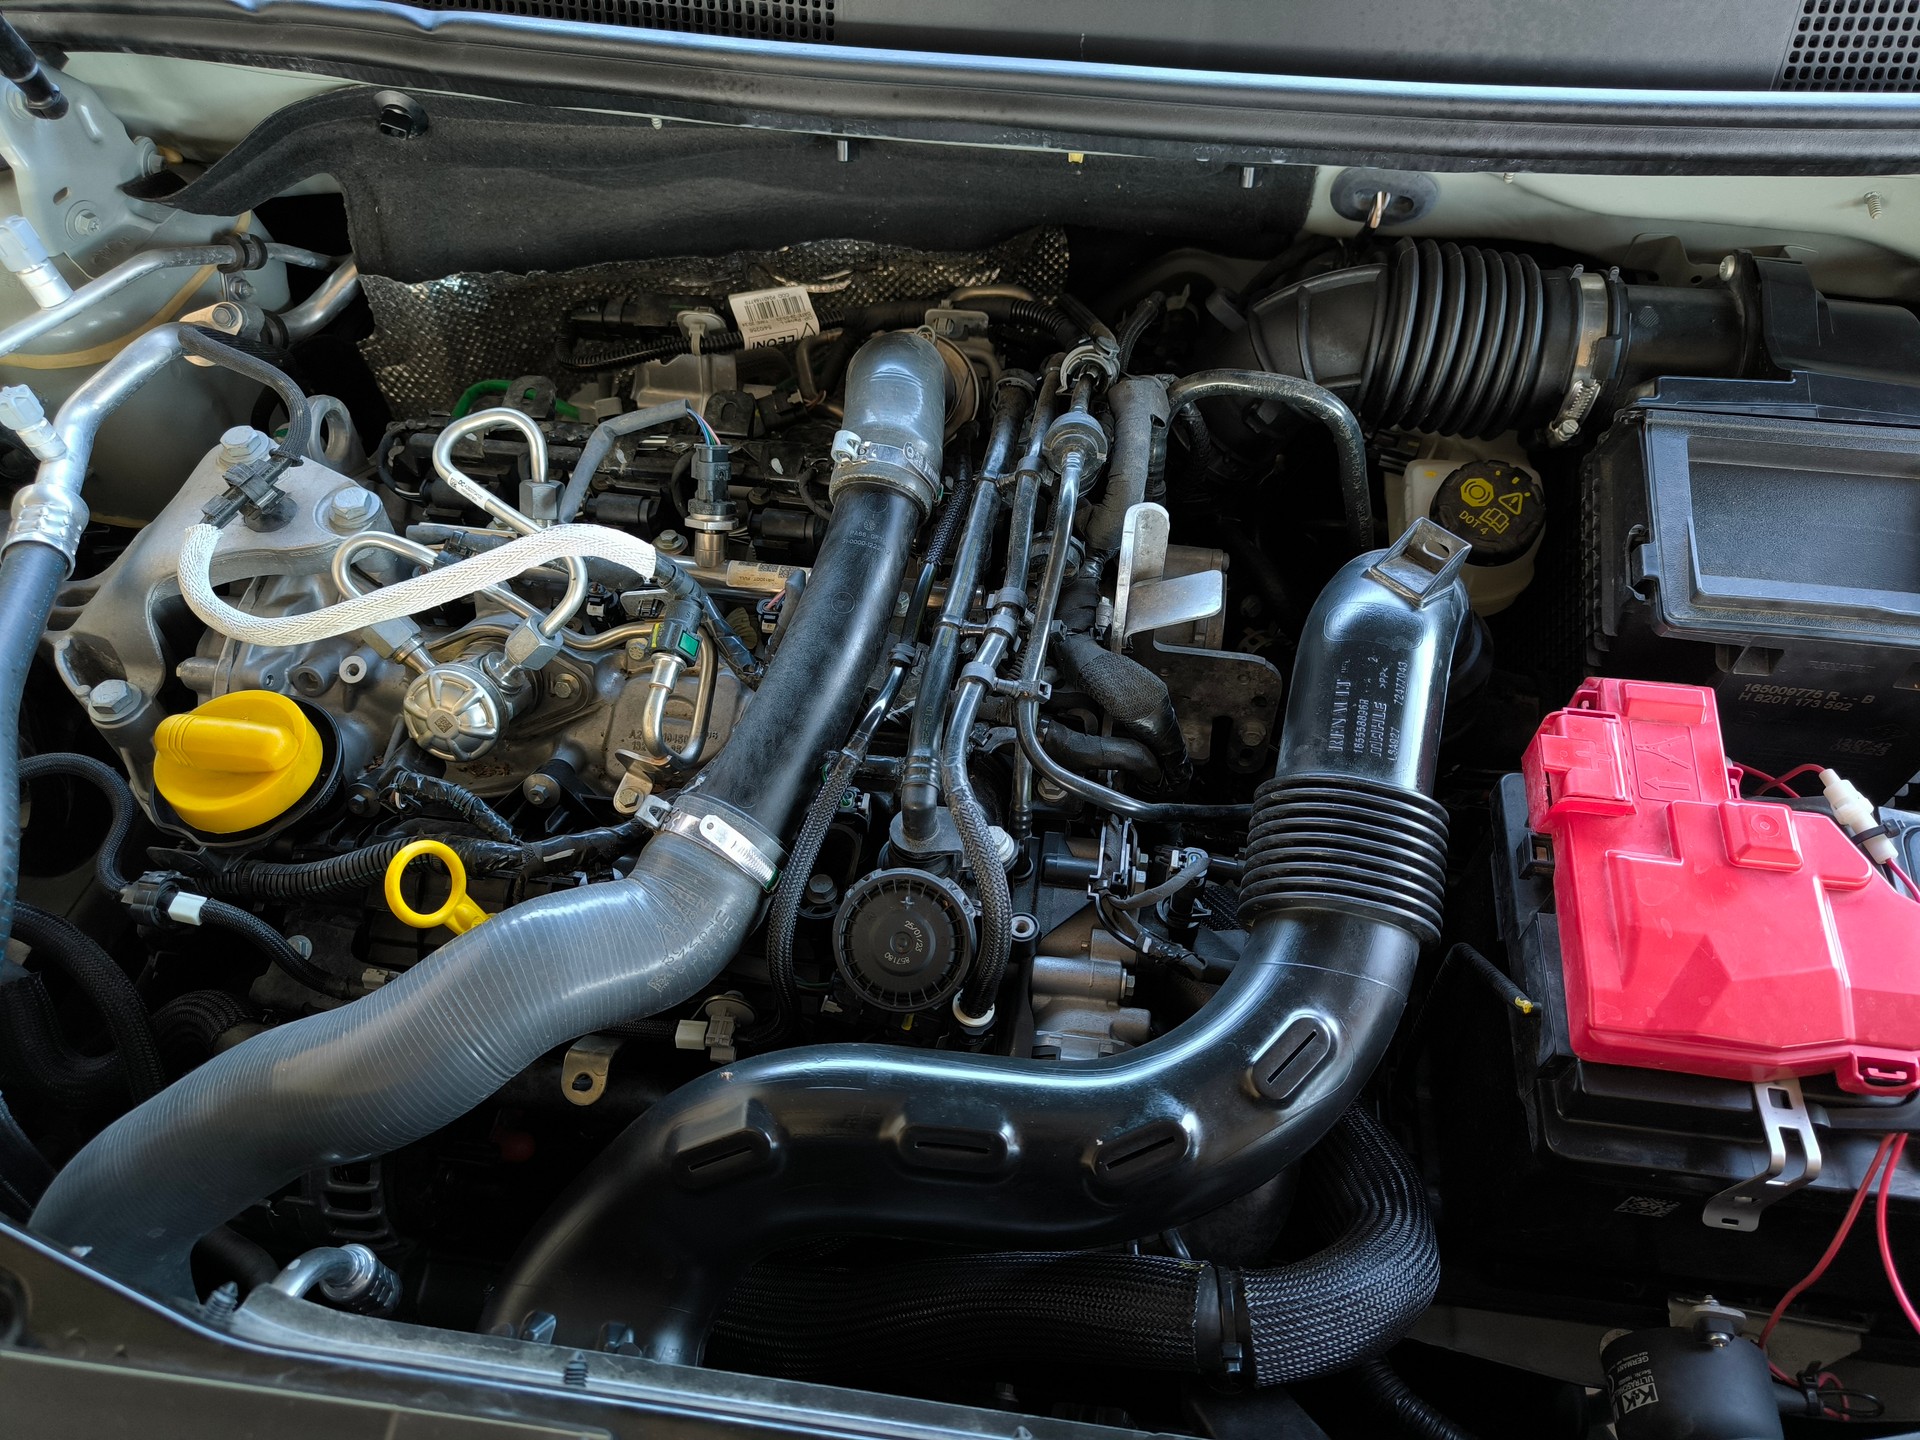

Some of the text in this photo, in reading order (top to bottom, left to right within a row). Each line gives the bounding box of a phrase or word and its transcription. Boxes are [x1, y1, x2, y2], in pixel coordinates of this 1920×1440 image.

[752, 334, 795, 349] LEONI
[1458, 510, 1489, 535] DOT 4
[1738, 692, 1854, 712] H 8201 173 592
[1744, 682, 1824, 699] 165009775
[1861, 694, 1876, 704] B
[1370, 702, 1388, 757] MAHLE
[904, 920, 923, 952] 25/01/23
[884, 952, 911, 964] 857180
[1622, 1384, 1658, 1412] K&K
